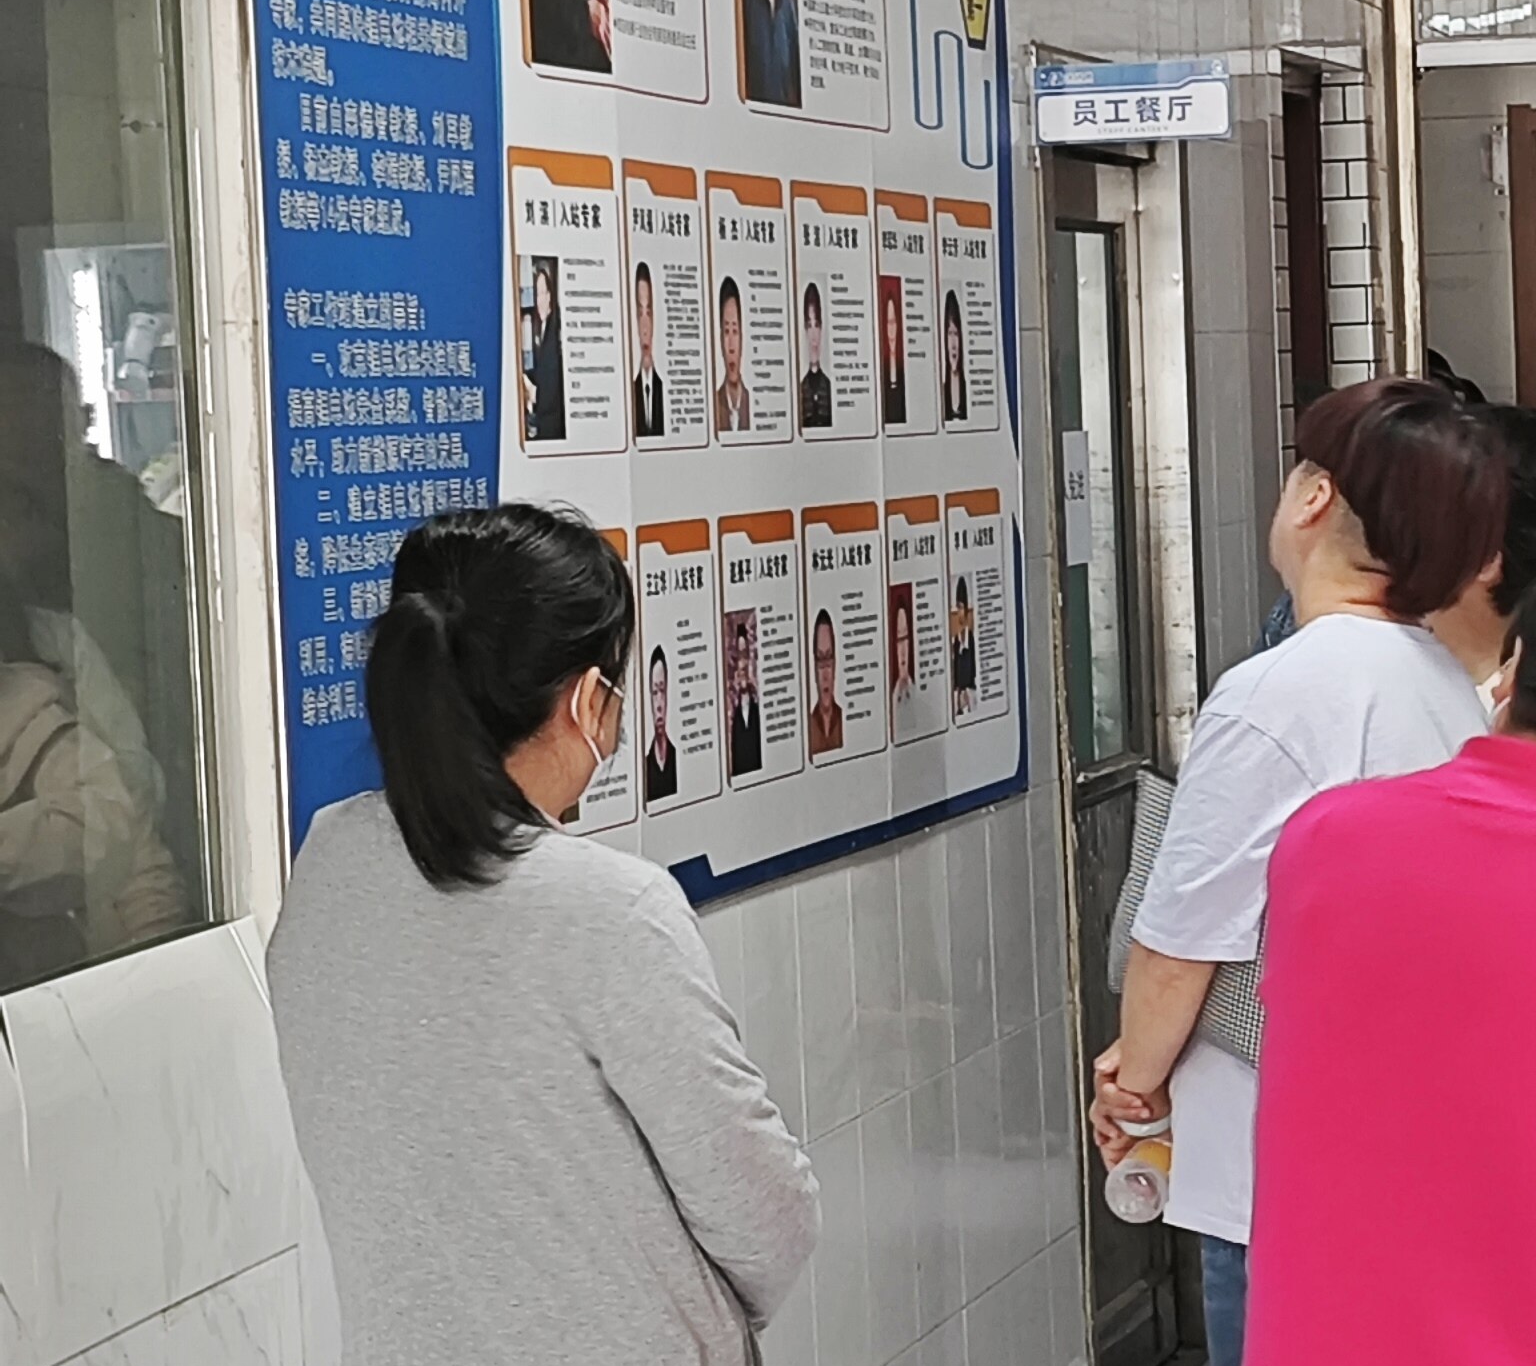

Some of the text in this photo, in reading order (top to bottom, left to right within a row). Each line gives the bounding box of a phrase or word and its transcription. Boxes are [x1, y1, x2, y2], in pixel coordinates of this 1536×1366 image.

[1073, 95, 1193, 126] 员工餐厅
[560, 202, 601, 228] 入站专家
